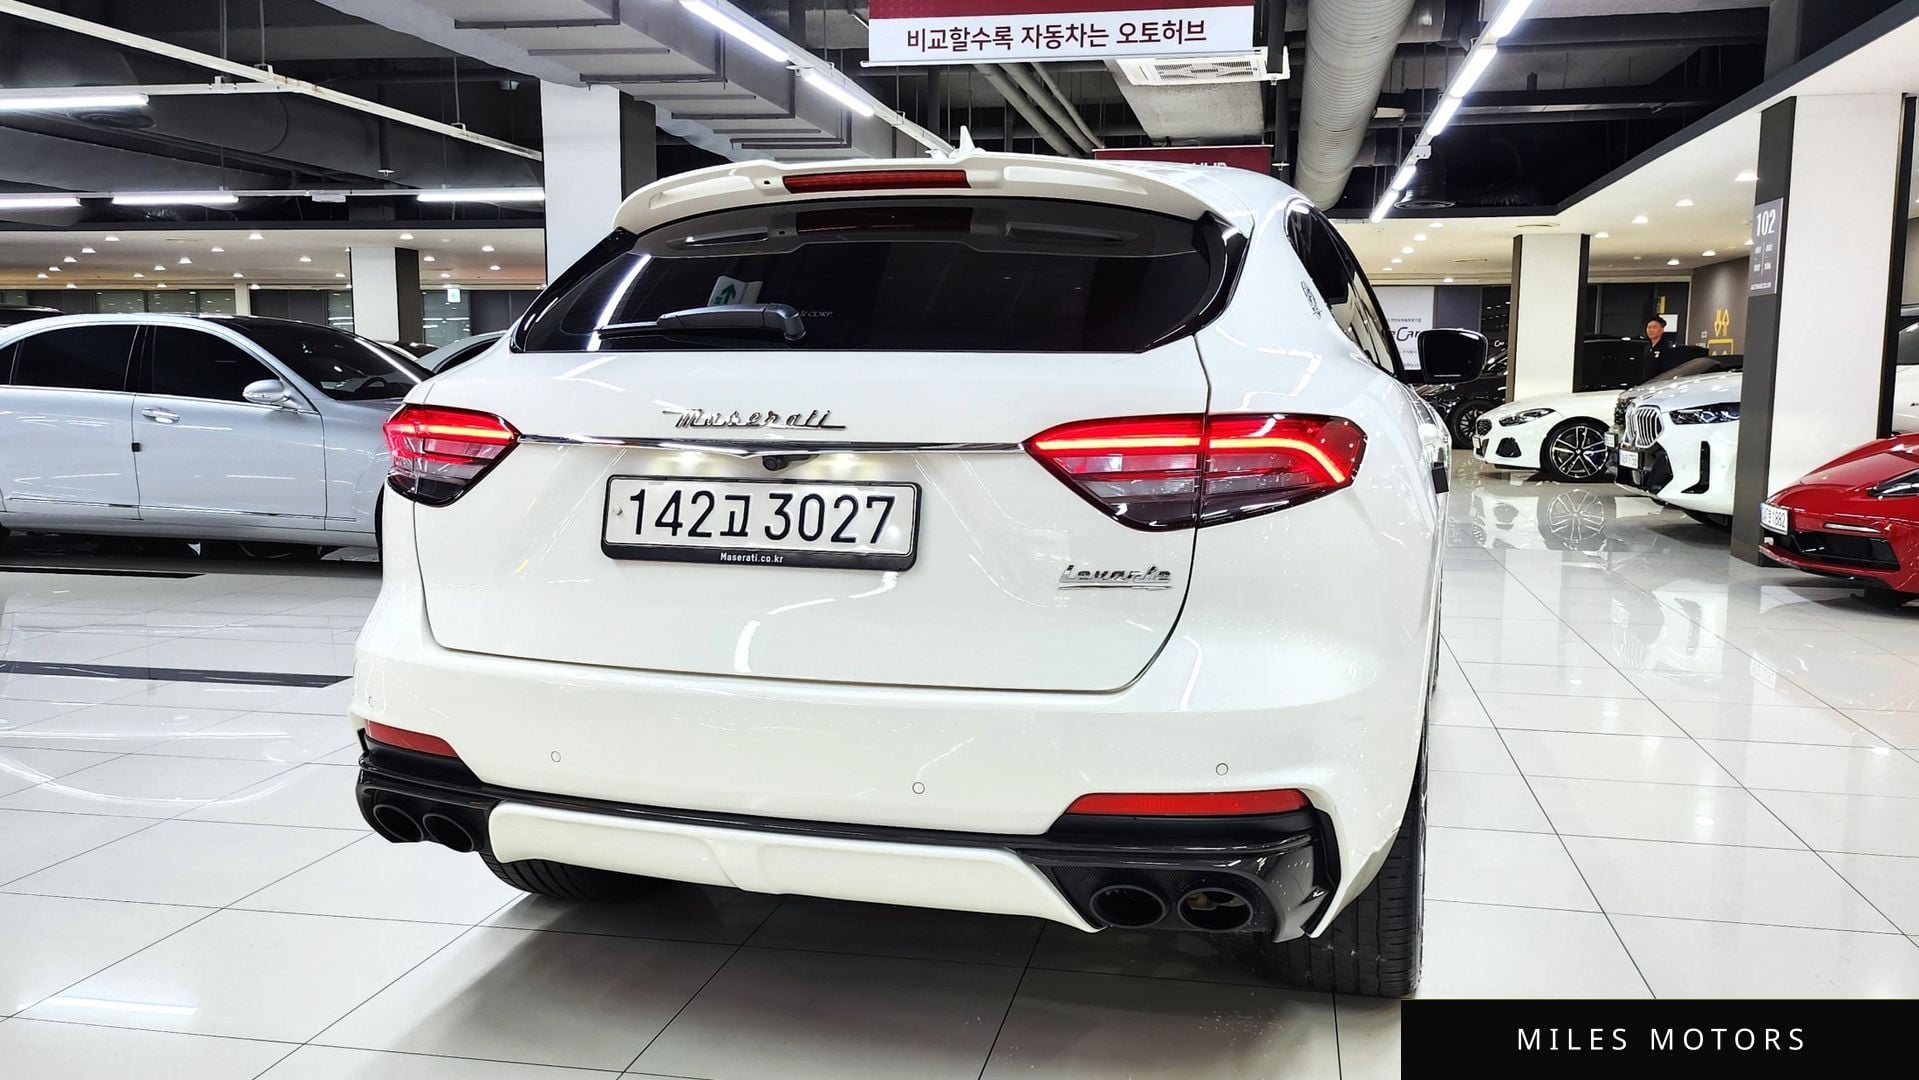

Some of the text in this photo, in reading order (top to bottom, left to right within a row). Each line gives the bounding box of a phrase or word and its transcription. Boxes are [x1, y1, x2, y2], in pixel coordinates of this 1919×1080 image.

[907, 19, 1206, 52] 비교할수록 자동차는 오토허브
[1756, 209, 1776, 237] 102
[662, 408, 847, 430] Maserati
[720, 552, 784, 564] Maserati.co.kr
[1059, 564, 1172, 591] Levante
